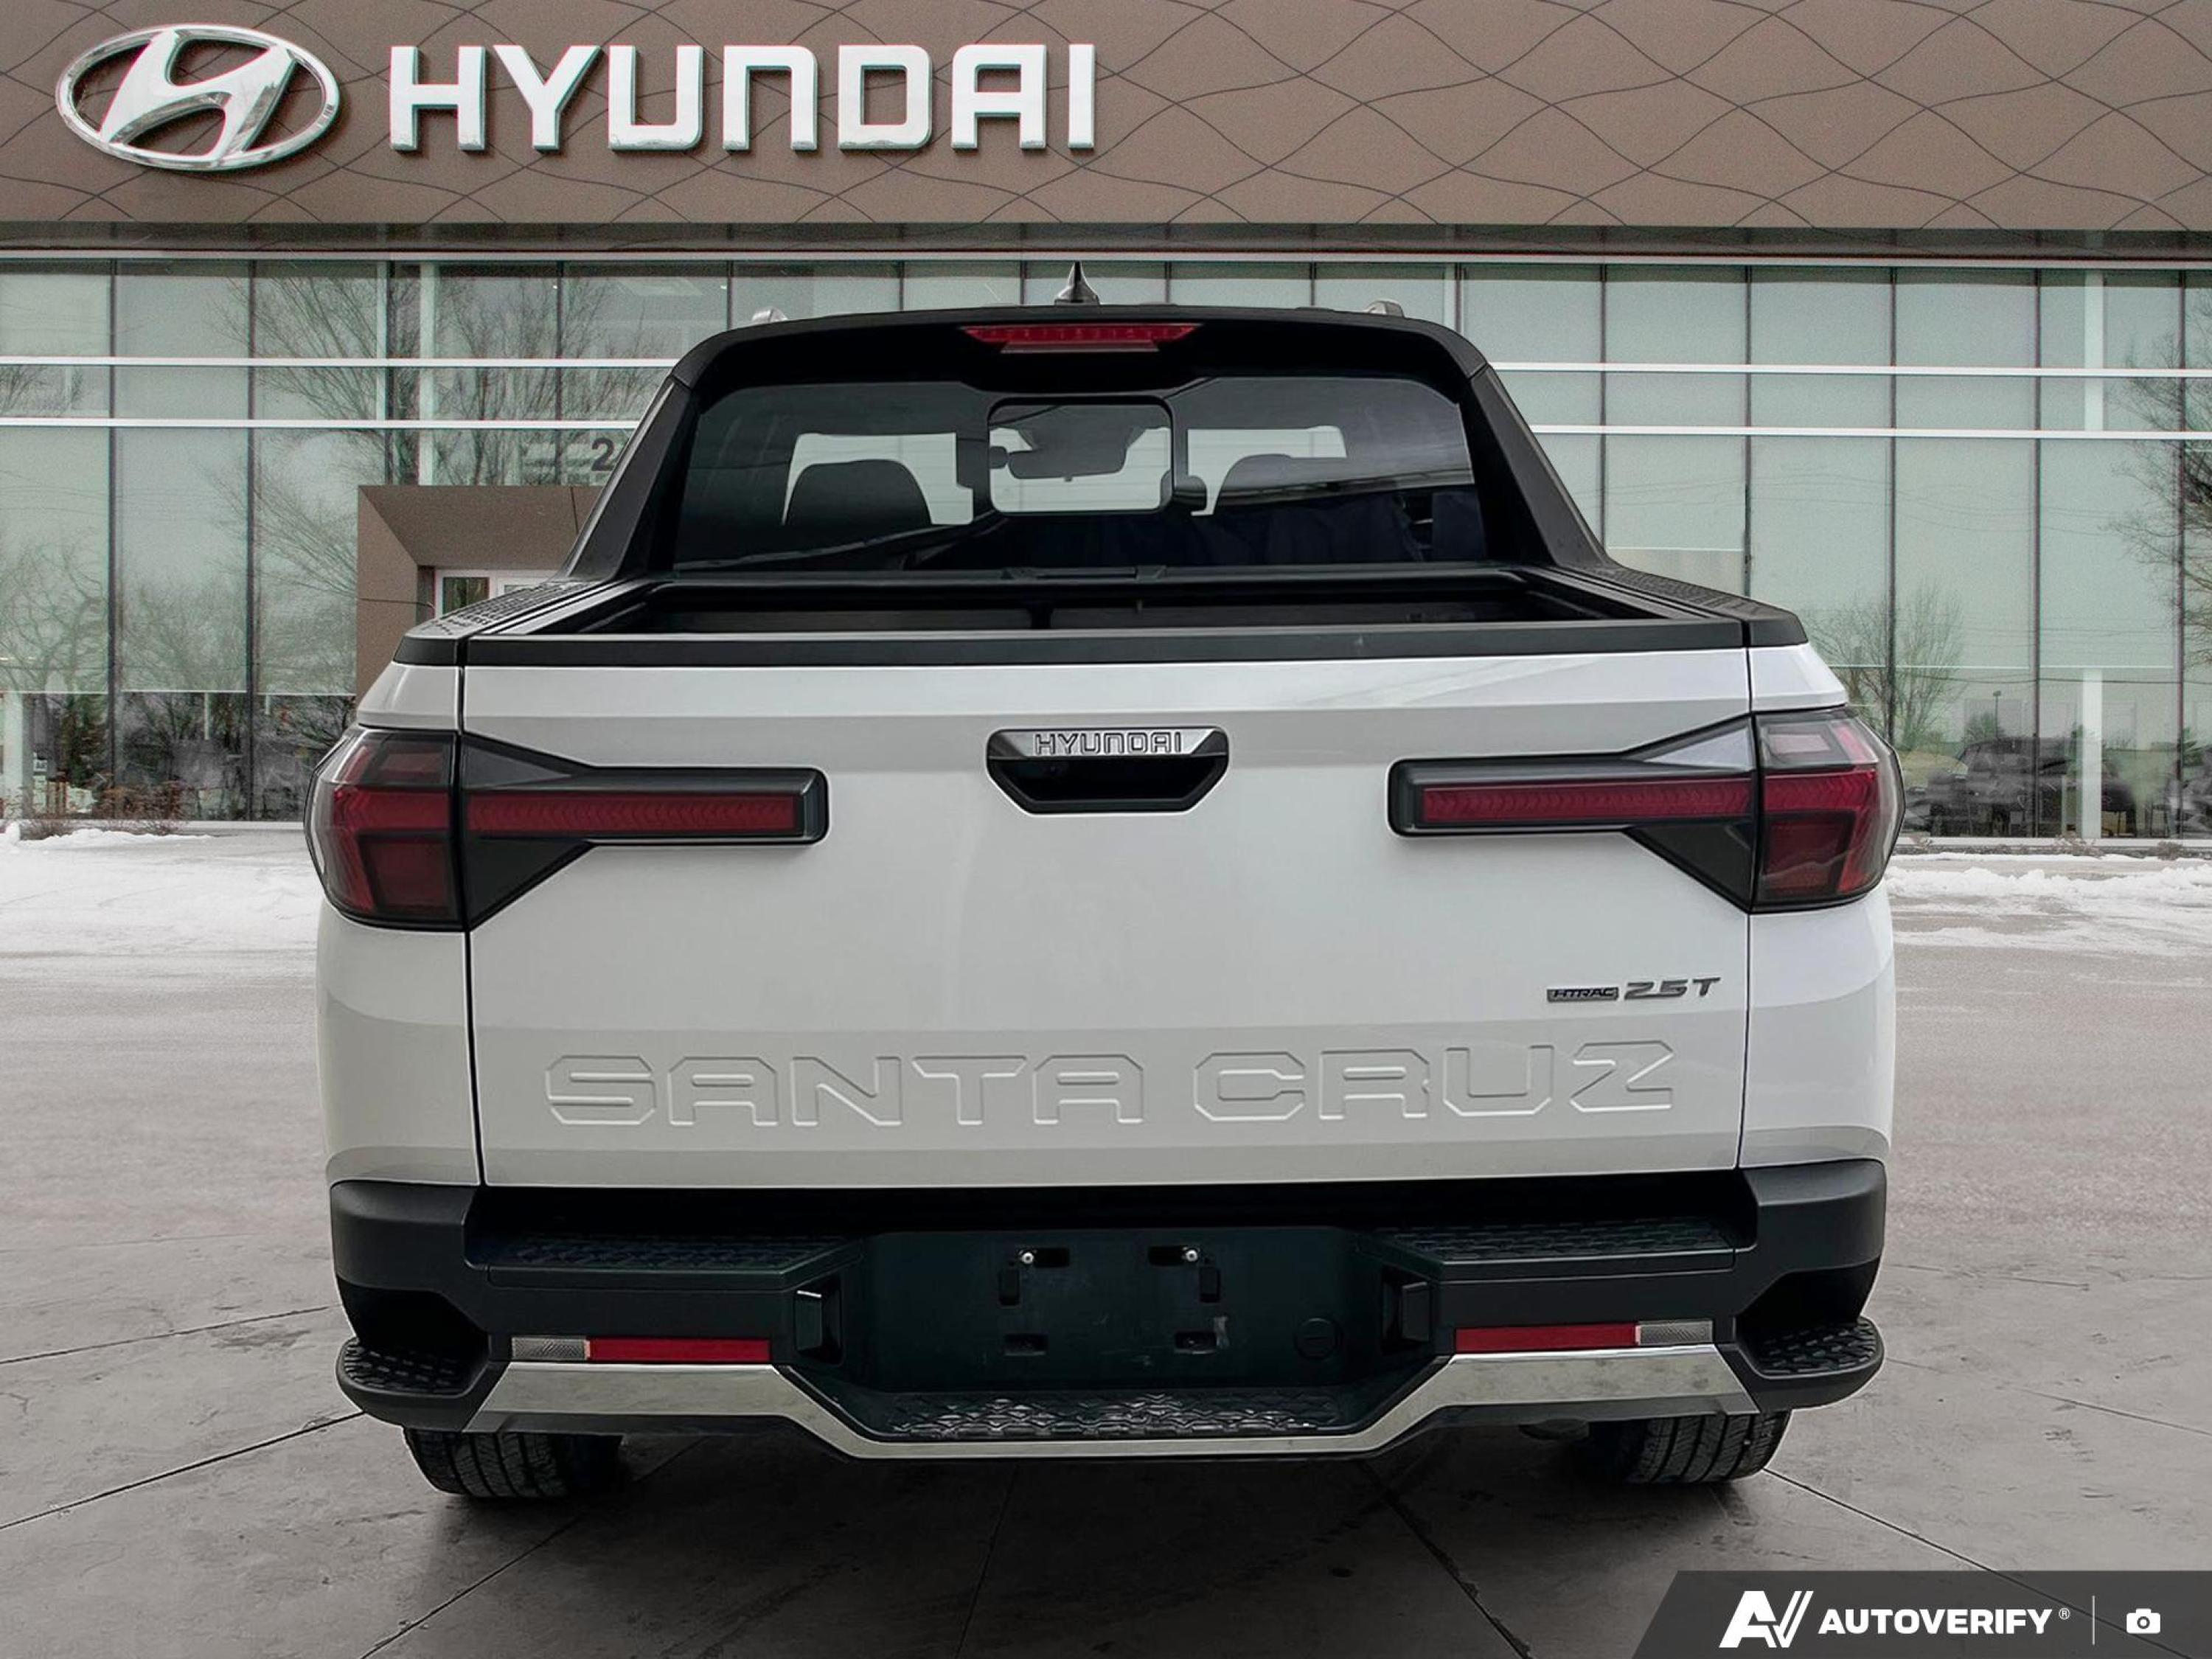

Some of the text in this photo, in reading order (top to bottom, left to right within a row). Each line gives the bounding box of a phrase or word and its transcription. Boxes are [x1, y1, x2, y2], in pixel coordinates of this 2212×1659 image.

[389, 44, 1096, 152] HYUNDAI
[591, 437, 616, 472] 2
[1034, 731, 1181, 755] HYUNDAI
[1552, 987, 1615, 998] HTRAC
[545, 1040, 1674, 1126] SANTA CRUZ
